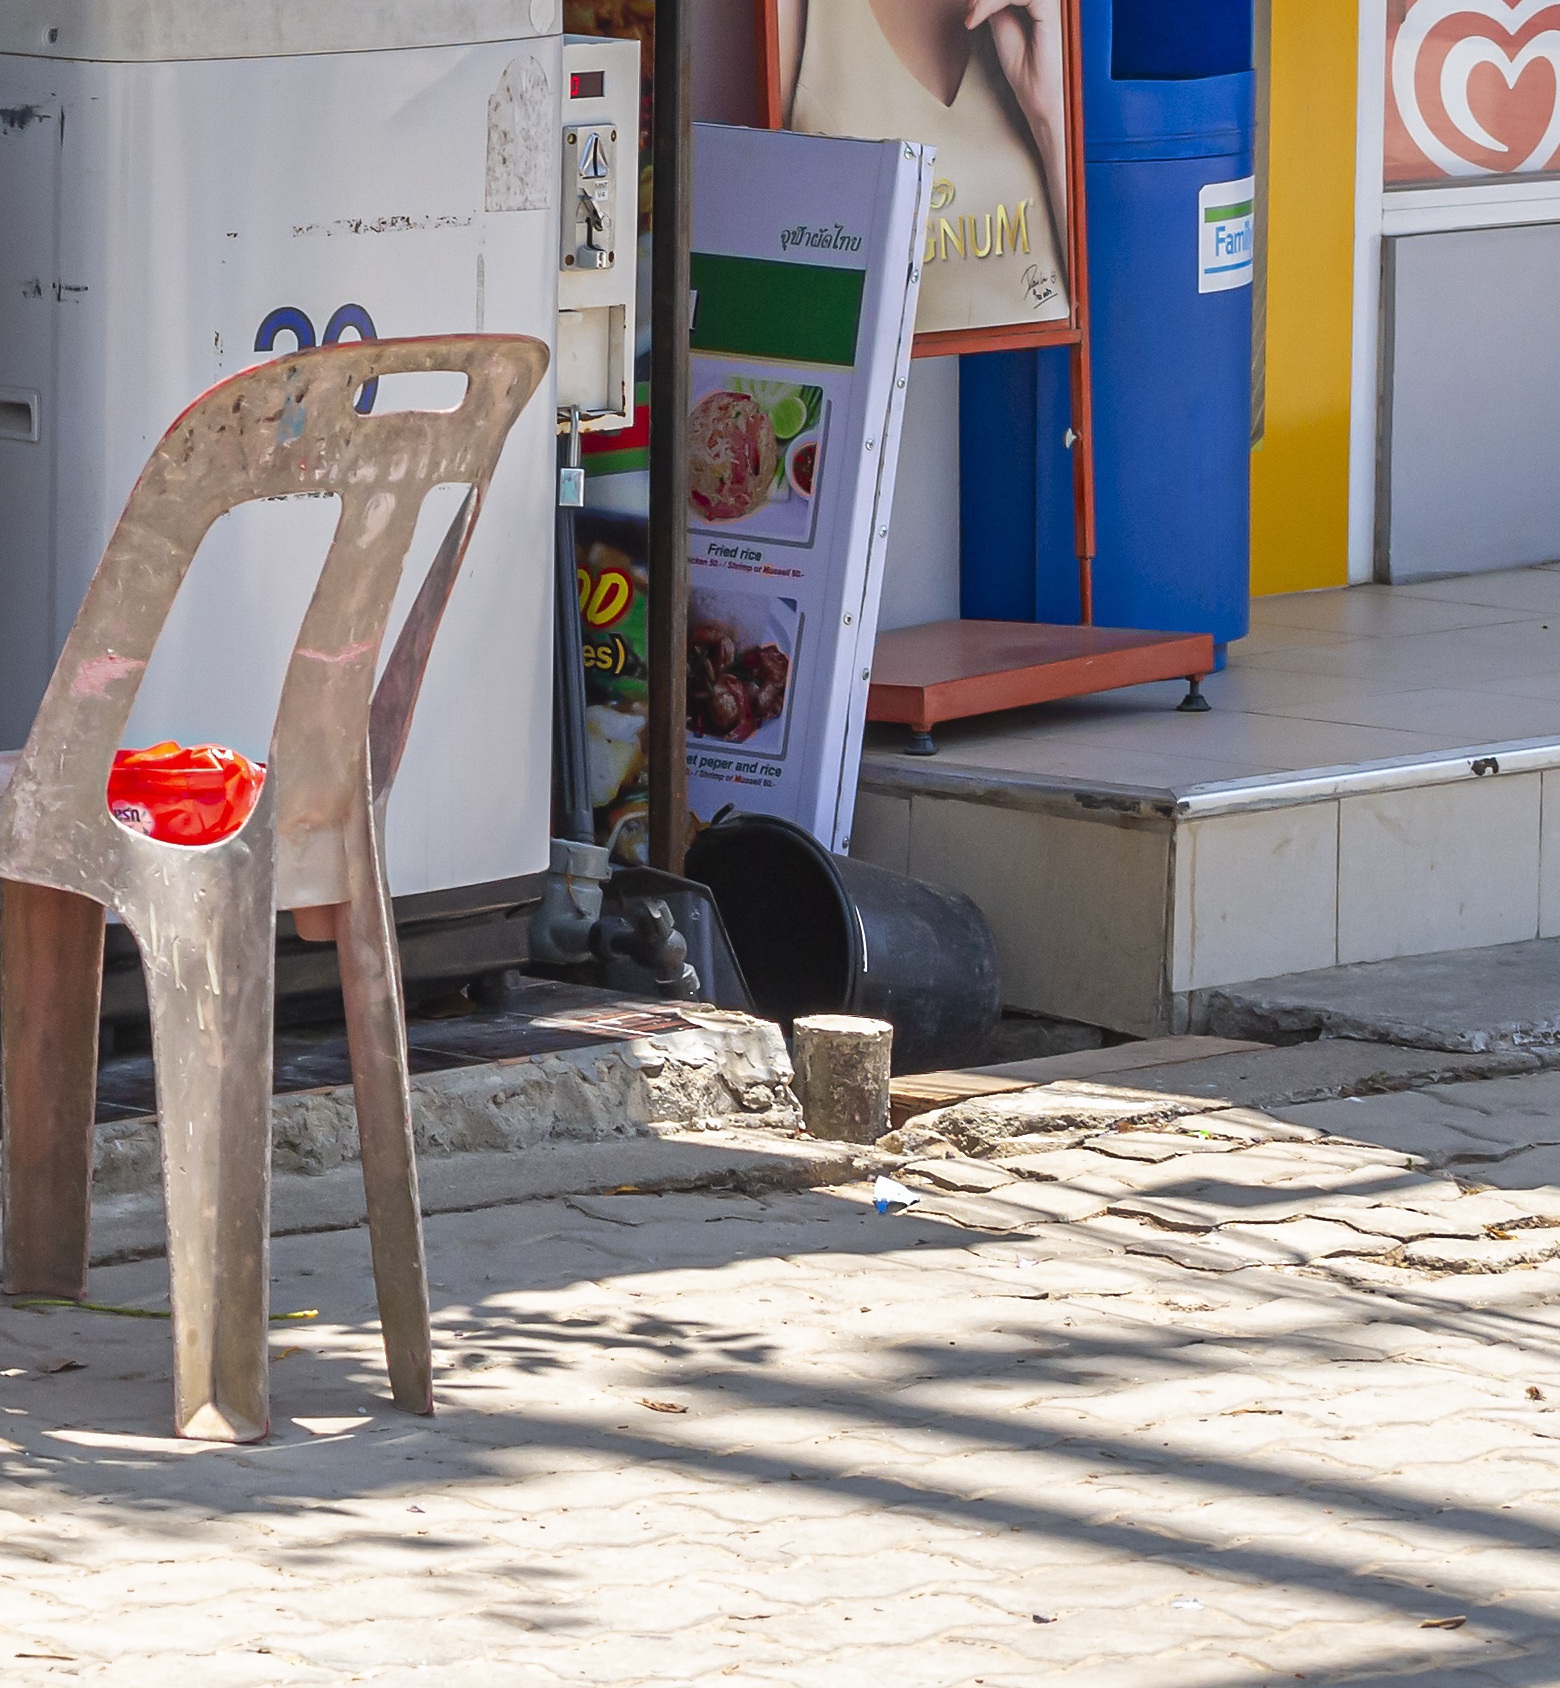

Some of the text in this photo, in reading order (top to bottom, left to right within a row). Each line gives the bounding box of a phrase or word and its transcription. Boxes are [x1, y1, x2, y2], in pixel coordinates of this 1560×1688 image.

[707, 543, 762, 562] Fried rice
[734, 761, 758, 774] and
[759, 763, 783, 778] rice
